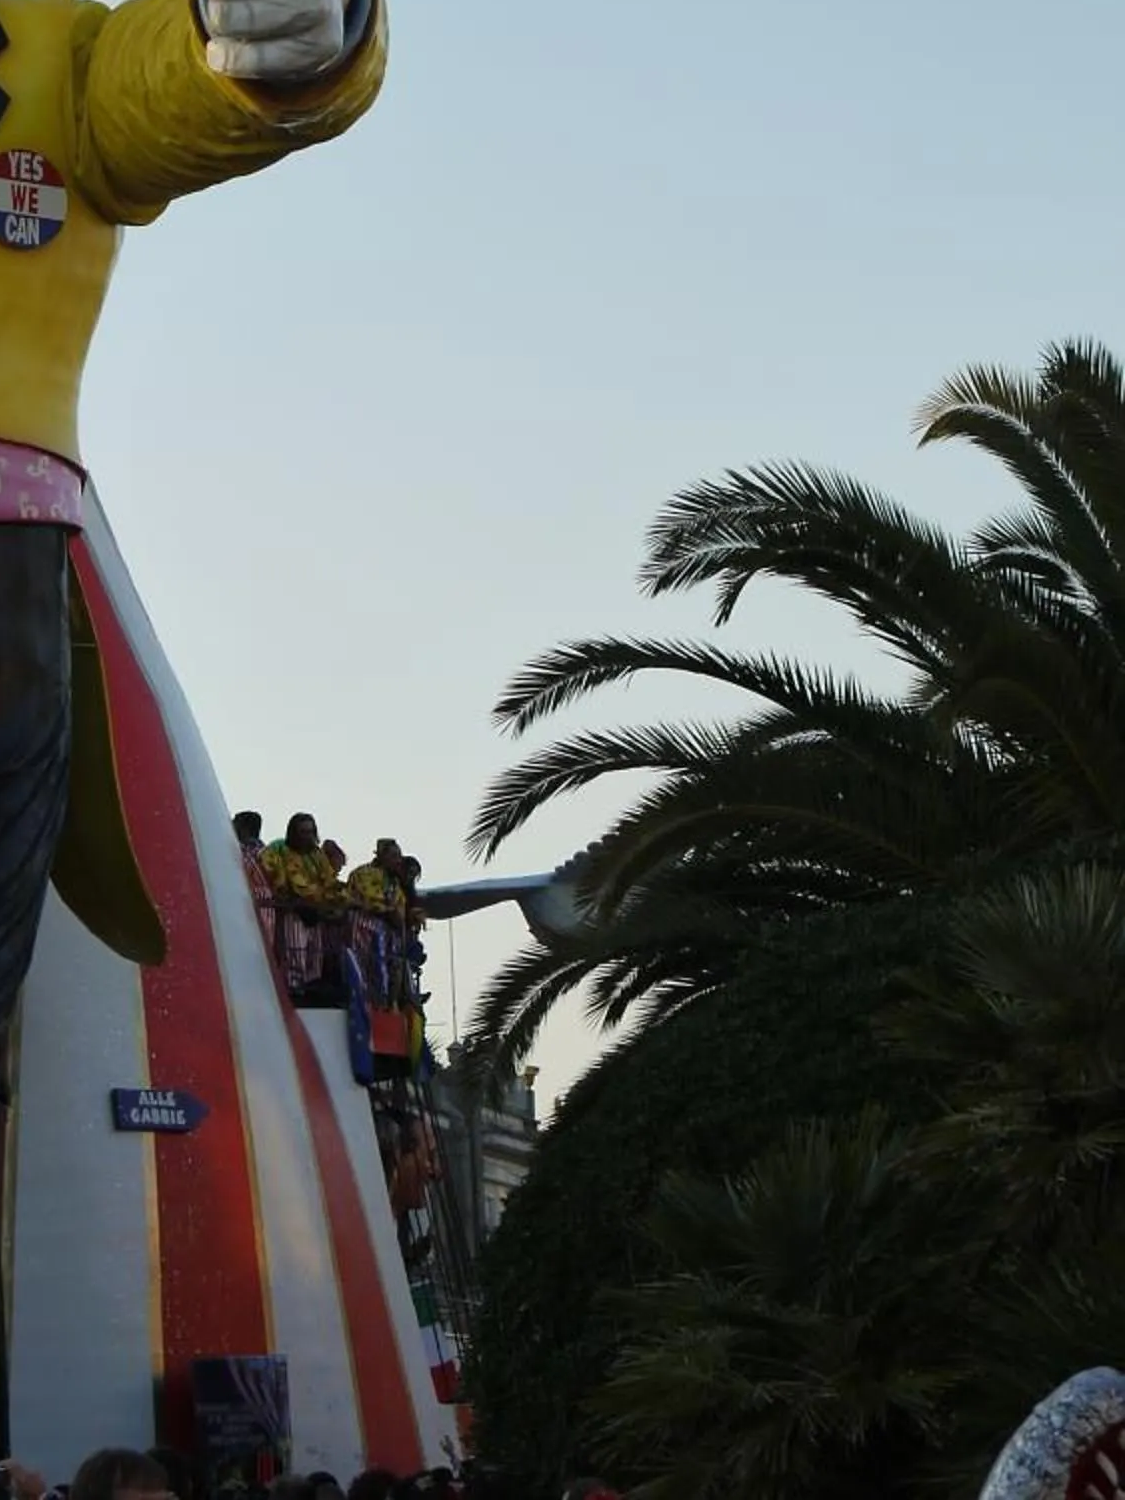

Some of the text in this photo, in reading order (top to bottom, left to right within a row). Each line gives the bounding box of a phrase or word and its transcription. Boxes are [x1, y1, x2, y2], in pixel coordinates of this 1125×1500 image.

[8, 152, 44, 182] YES
[11, 183, 39, 214] WE
[4, 215, 40, 245] CAN
[138, 1091, 176, 1106] ALLE
